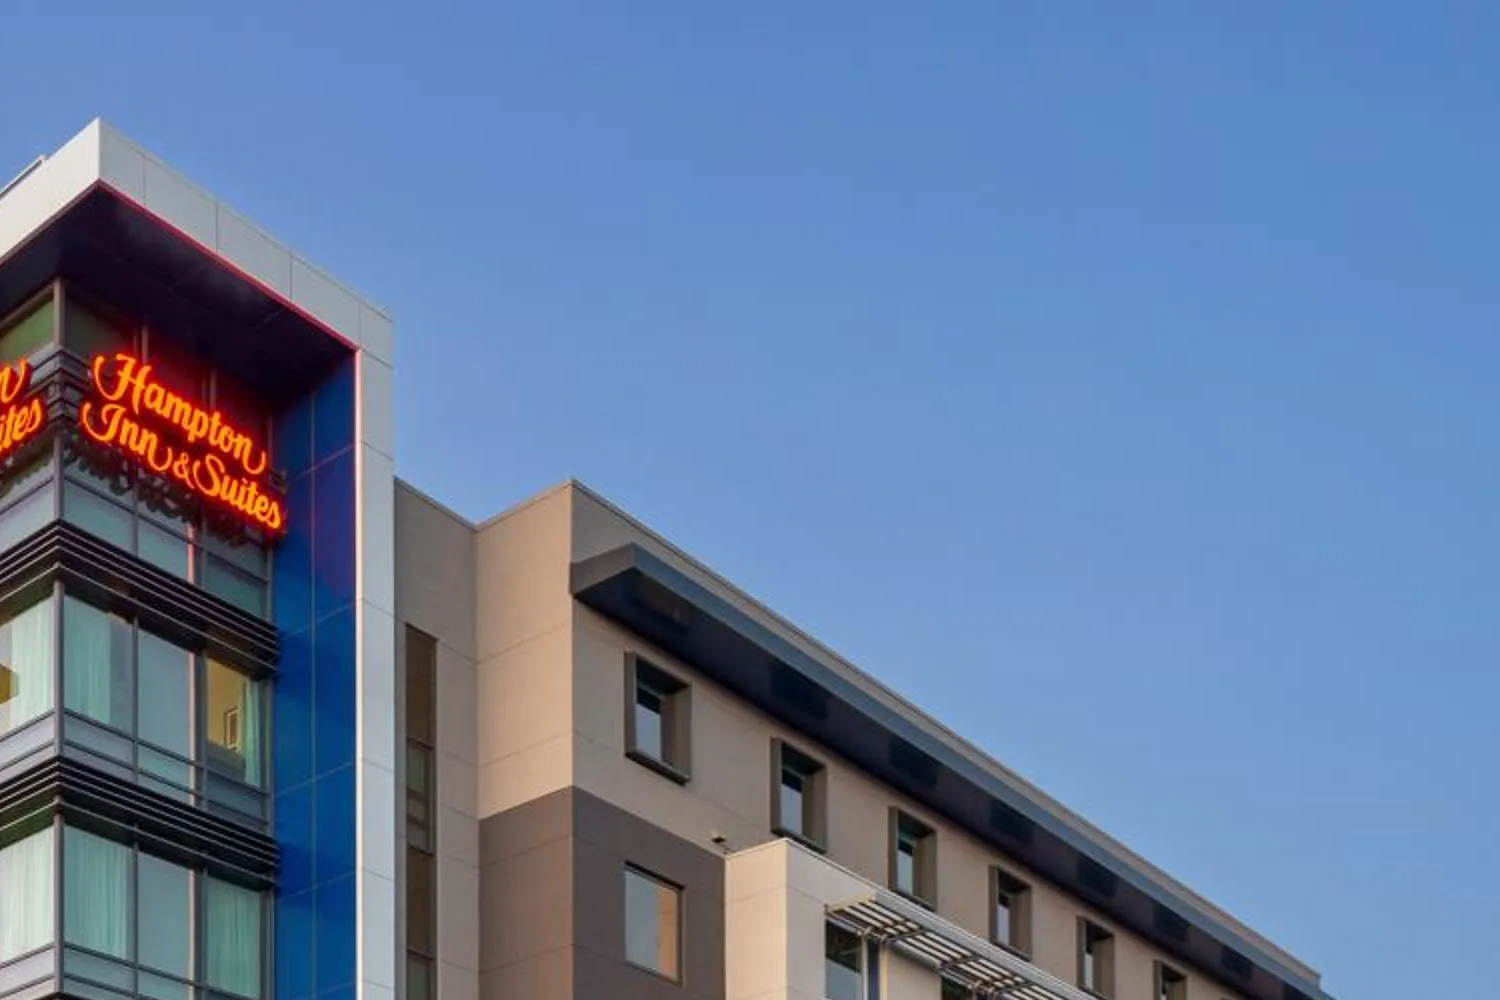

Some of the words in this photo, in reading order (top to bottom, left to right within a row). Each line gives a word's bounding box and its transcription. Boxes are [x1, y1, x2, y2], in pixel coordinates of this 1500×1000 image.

[81, 402, 173, 471] Inn
[173, 452, 195, 489] &
[192, 453, 281, 529] Suites
[93, 353, 267, 475] Hampton
